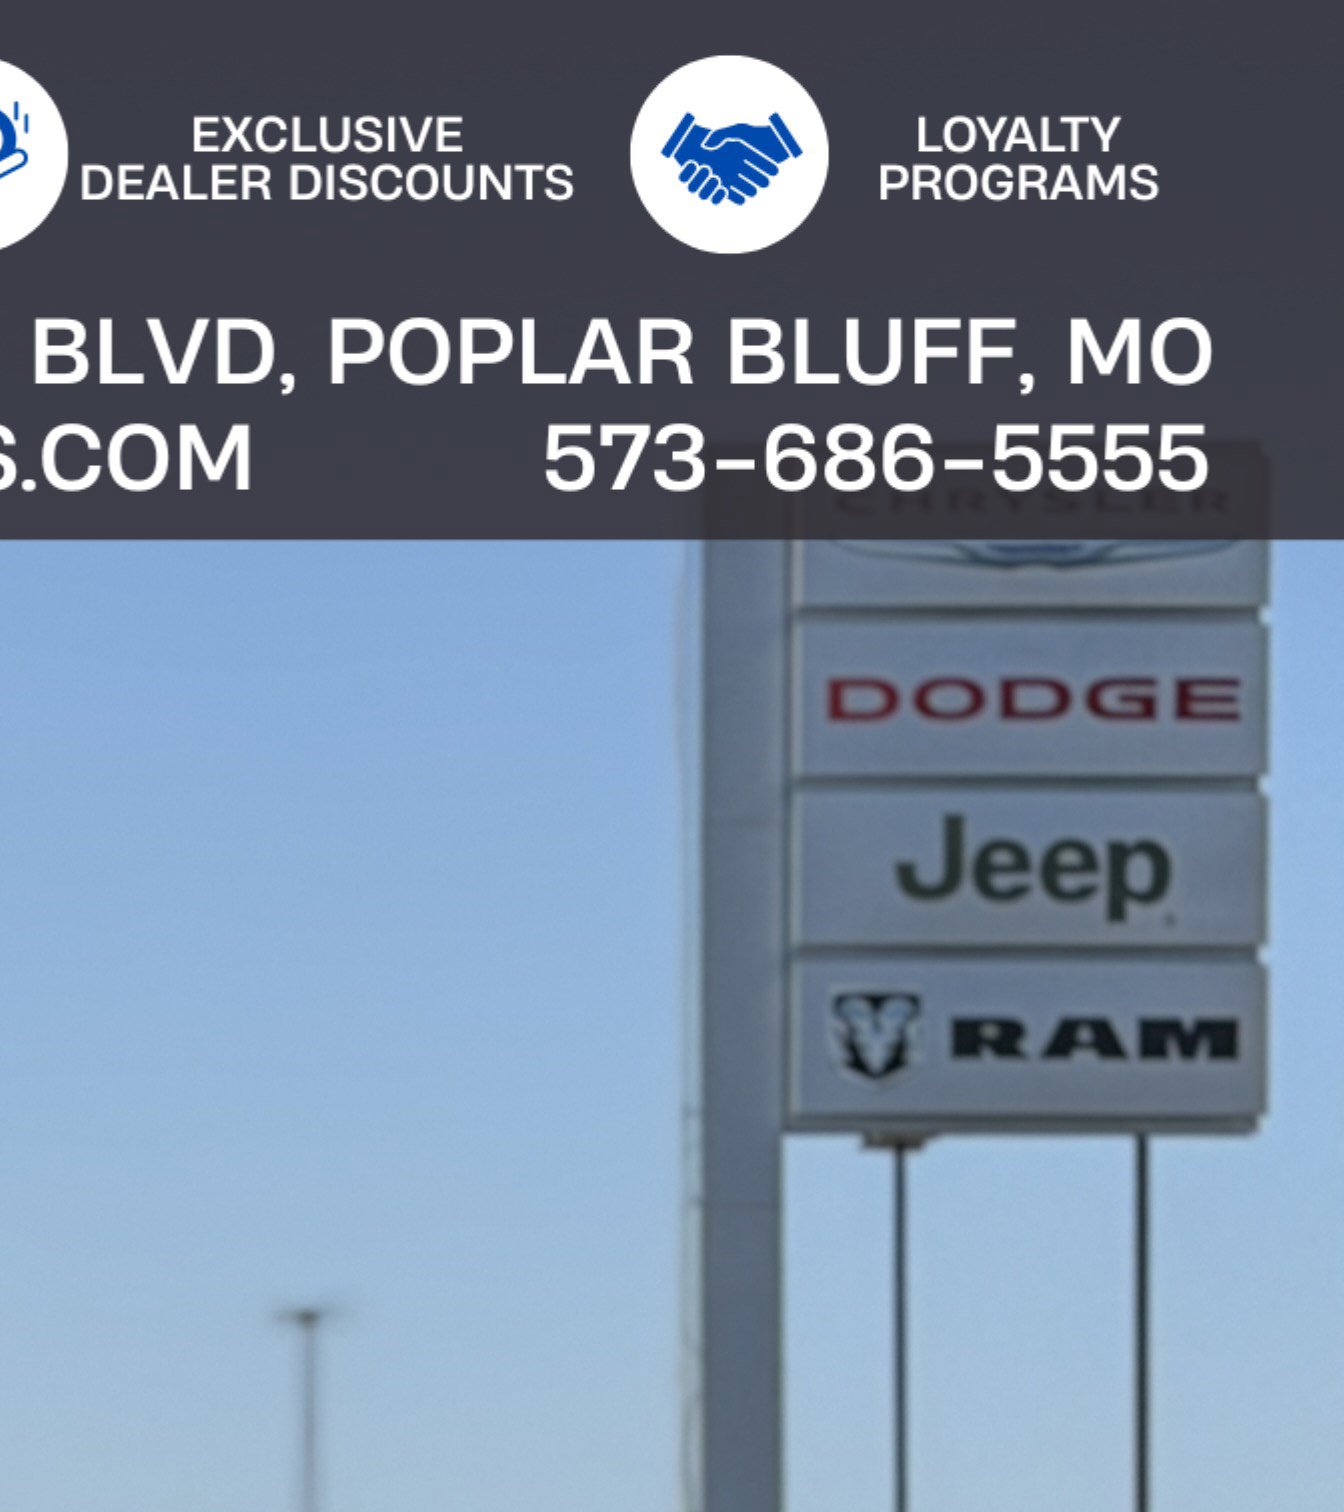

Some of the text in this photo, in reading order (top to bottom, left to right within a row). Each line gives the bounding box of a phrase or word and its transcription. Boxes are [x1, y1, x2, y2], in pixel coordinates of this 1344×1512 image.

[827, 677, 1243, 723] DODGE
[896, 813, 1172, 924] Jeep
[949, 1017, 1241, 1061] RAM
